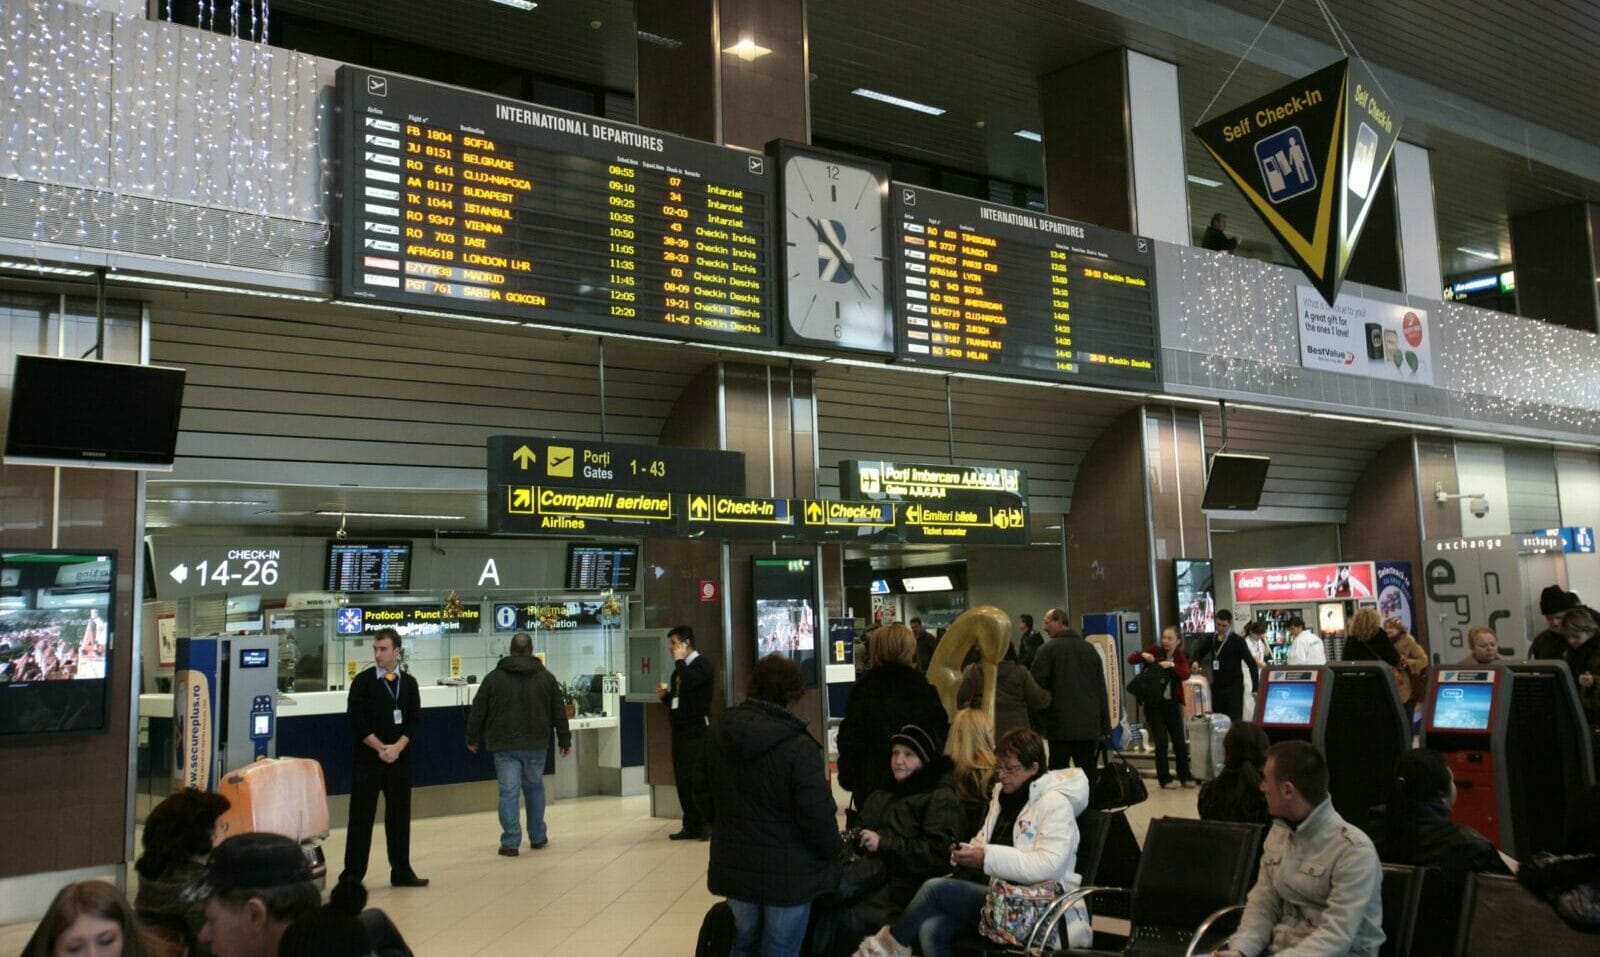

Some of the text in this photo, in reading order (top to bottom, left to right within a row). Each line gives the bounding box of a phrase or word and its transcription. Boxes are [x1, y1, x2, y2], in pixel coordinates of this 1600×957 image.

[1355, 85, 1368, 110] Self
[496, 104, 663, 152] INTERNATIONAL DEPARTURES
[1223, 89, 1322, 142] Self Check-In
[407, 126, 420, 137] FB
[428, 130, 452, 142] 1804
[464, 137, 494, 150] SOFIA
[670, 177, 681, 187] 07
[407, 143, 420, 153] JU
[426, 146, 451, 159] 8151
[464, 154, 514, 171] BELGRADE
[609, 181, 635, 193] 09:10
[670, 192, 681, 201] 34
[826, 166, 840, 180] 12
[407, 161, 423, 171] RO
[435, 165, 454, 176] 641
[464, 171, 531, 190] CLUJ-NAPOCA
[610, 196, 635, 208] 09:25
[663, 206, 688, 218] 02-03
[408, 178, 421, 188] AA
[427, 181, 453, 193] 8117
[464, 187, 513, 203] BUDAPEST
[610, 212, 634, 223] 10:35
[670, 222, 682, 232] 43
[408, 194, 420, 204] TK
[427, 198, 452, 209] 1044
[464, 203, 512, 219] ISTANBUL
[610, 228, 634, 240] 10:50
[407, 211, 423, 221] RO
[428, 214, 455, 226] 9347
[465, 220, 503, 234] VIENNA
[610, 243, 634, 255] 11:05
[980, 207, 1085, 238] INTERNATIONAL DEPARTURES
[407, 229, 423, 239] RO
[435, 232, 454, 243] 703
[464, 237, 486, 248] IASI
[610, 259, 634, 270] 11:35
[407, 246, 454, 260] AFR6618
[463, 254, 506, 268] LONDON
[511, 259, 531, 271] LHR
[610, 274, 634, 286] 11:45
[464, 270, 504, 283] MADRID
[610, 290, 635, 302] 12:05
[665, 298, 689, 309] 19-21
[506, 292, 545, 306] GOKCEN
[611, 306, 635, 317] 12:20
[1305, 311, 1309, 319] A
[834, 325, 842, 339] 6
[1307, 345, 1345, 359] BestValue
[584, 466, 613, 480] Gates
[630, 460, 636, 475] 1
[650, 462, 665, 477] 43
[541, 490, 668, 511] Companii aeriene
[717, 499, 773, 515] Check-in
[830, 503, 881, 519] Check-in
[541, 516, 584, 529] Airlines
[923, 510, 952, 523] Emiteri
[922, 527, 941, 536] Ticket
[228, 550, 279, 560] CHECK-IN
[1437, 539, 1501, 550] exchange
[196, 560, 278, 586] 14-26
[478, 558, 500, 586] A
[365, 610, 440, 620] Protocol Punct
